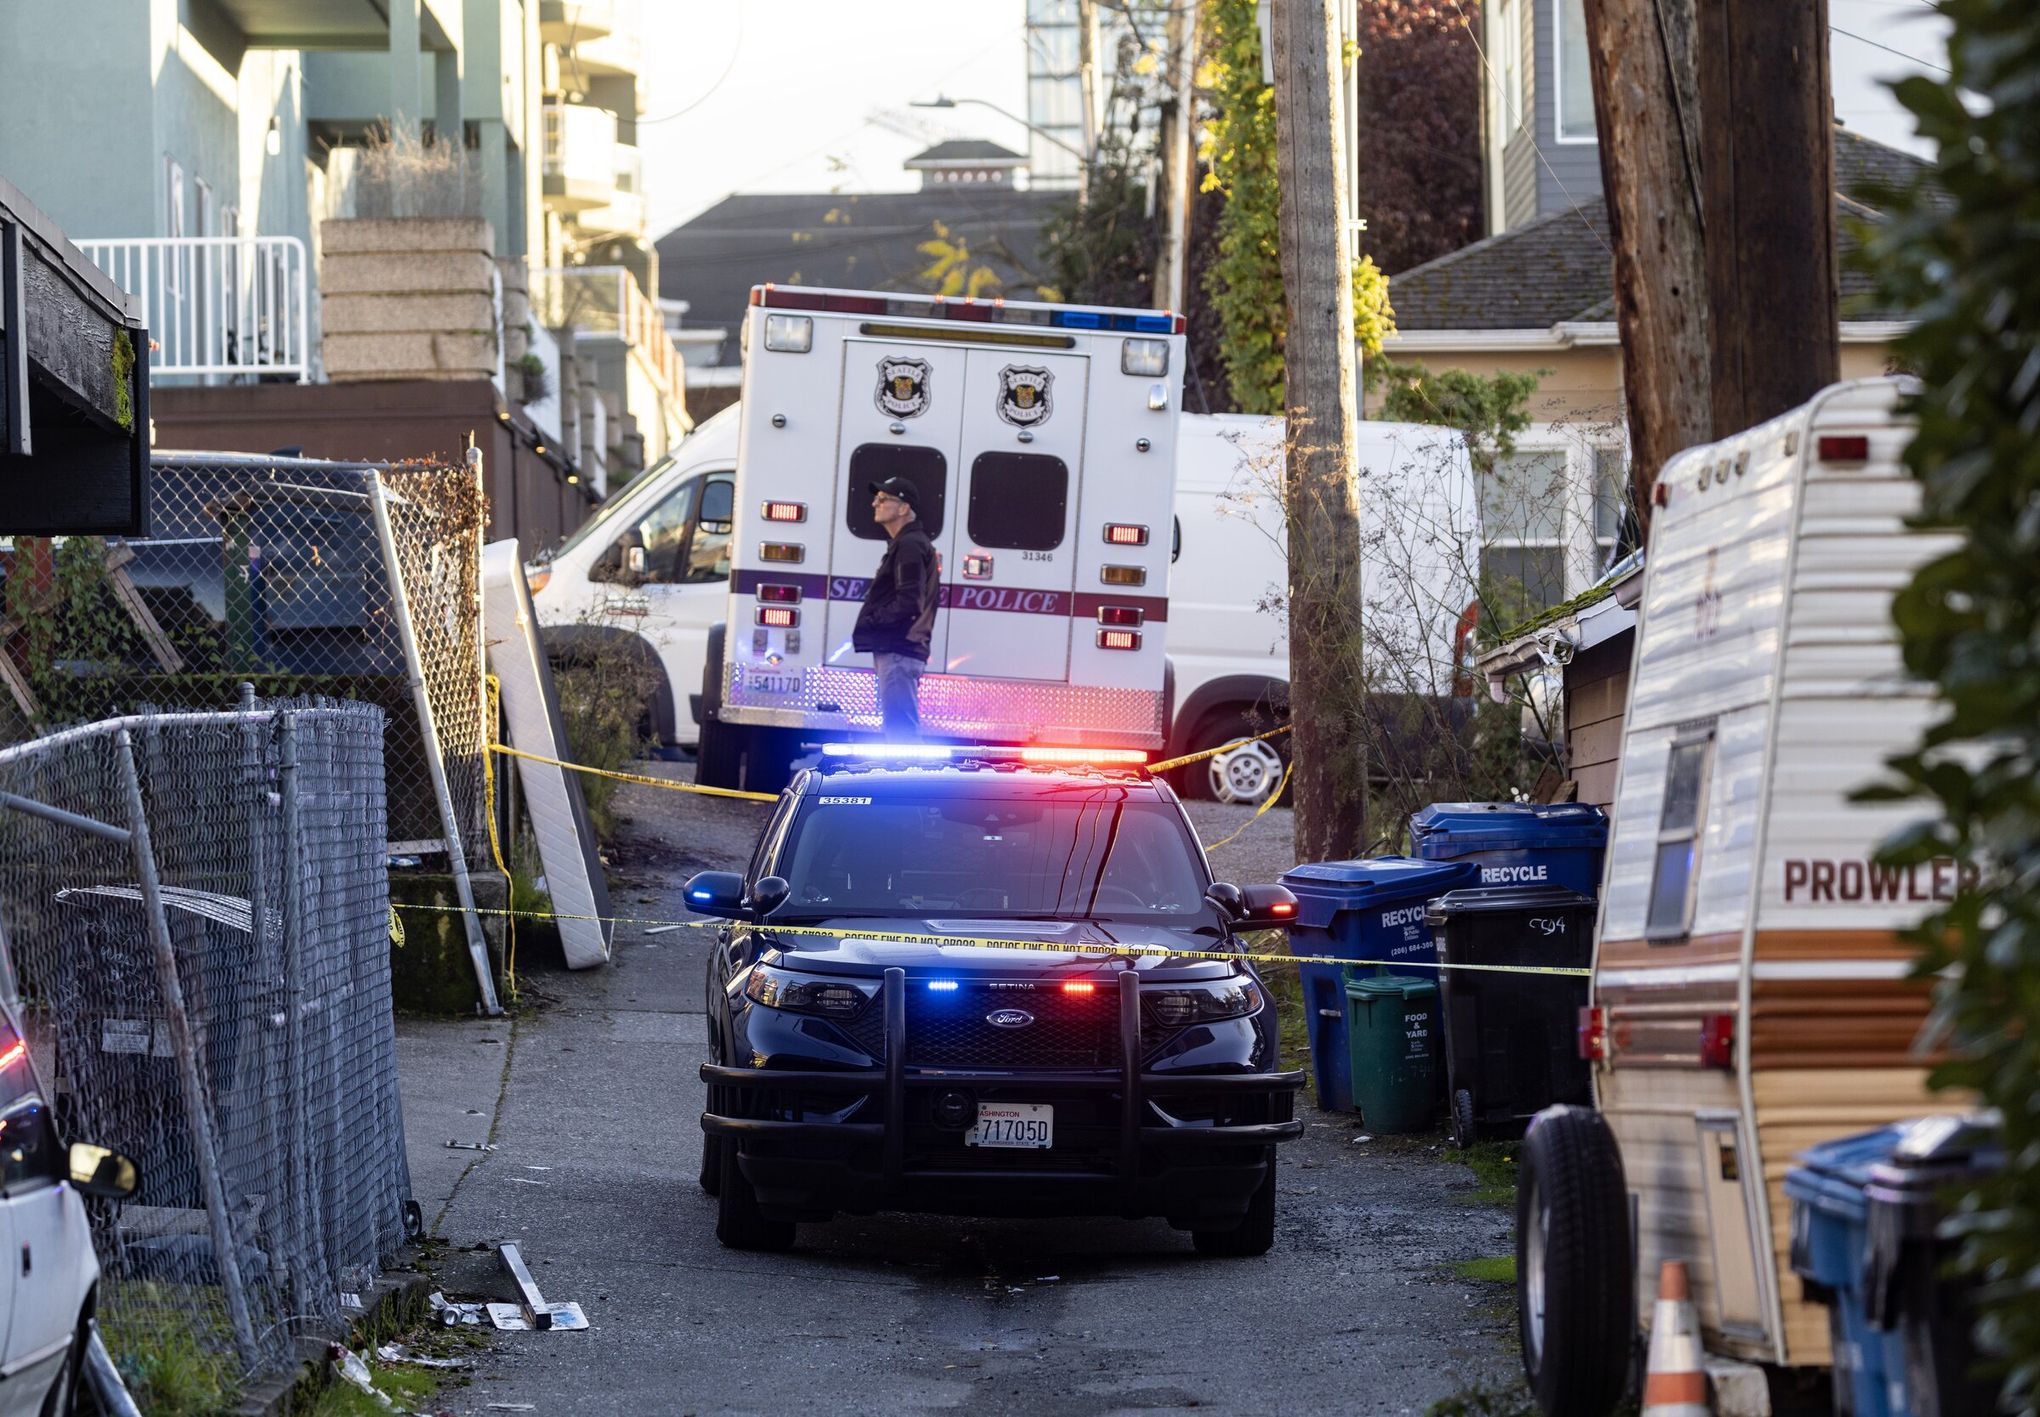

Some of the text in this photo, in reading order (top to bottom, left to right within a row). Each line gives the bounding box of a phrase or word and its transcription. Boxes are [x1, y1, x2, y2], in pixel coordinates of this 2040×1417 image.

[1021, 550, 1054, 562] 31346
[958, 587, 1059, 613] POLICE
[1480, 864, 1548, 883] RECYCLE
[997, 1012, 1024, 1024] Ford
[1404, 1012, 1428, 1023] FOOD
[1413, 1021, 1420, 1030] &
[1406, 1029, 1428, 1039] YARD
[977, 1110, 1020, 1118] ASHINGTON
[983, 1119, 1048, 1142] 71705D
